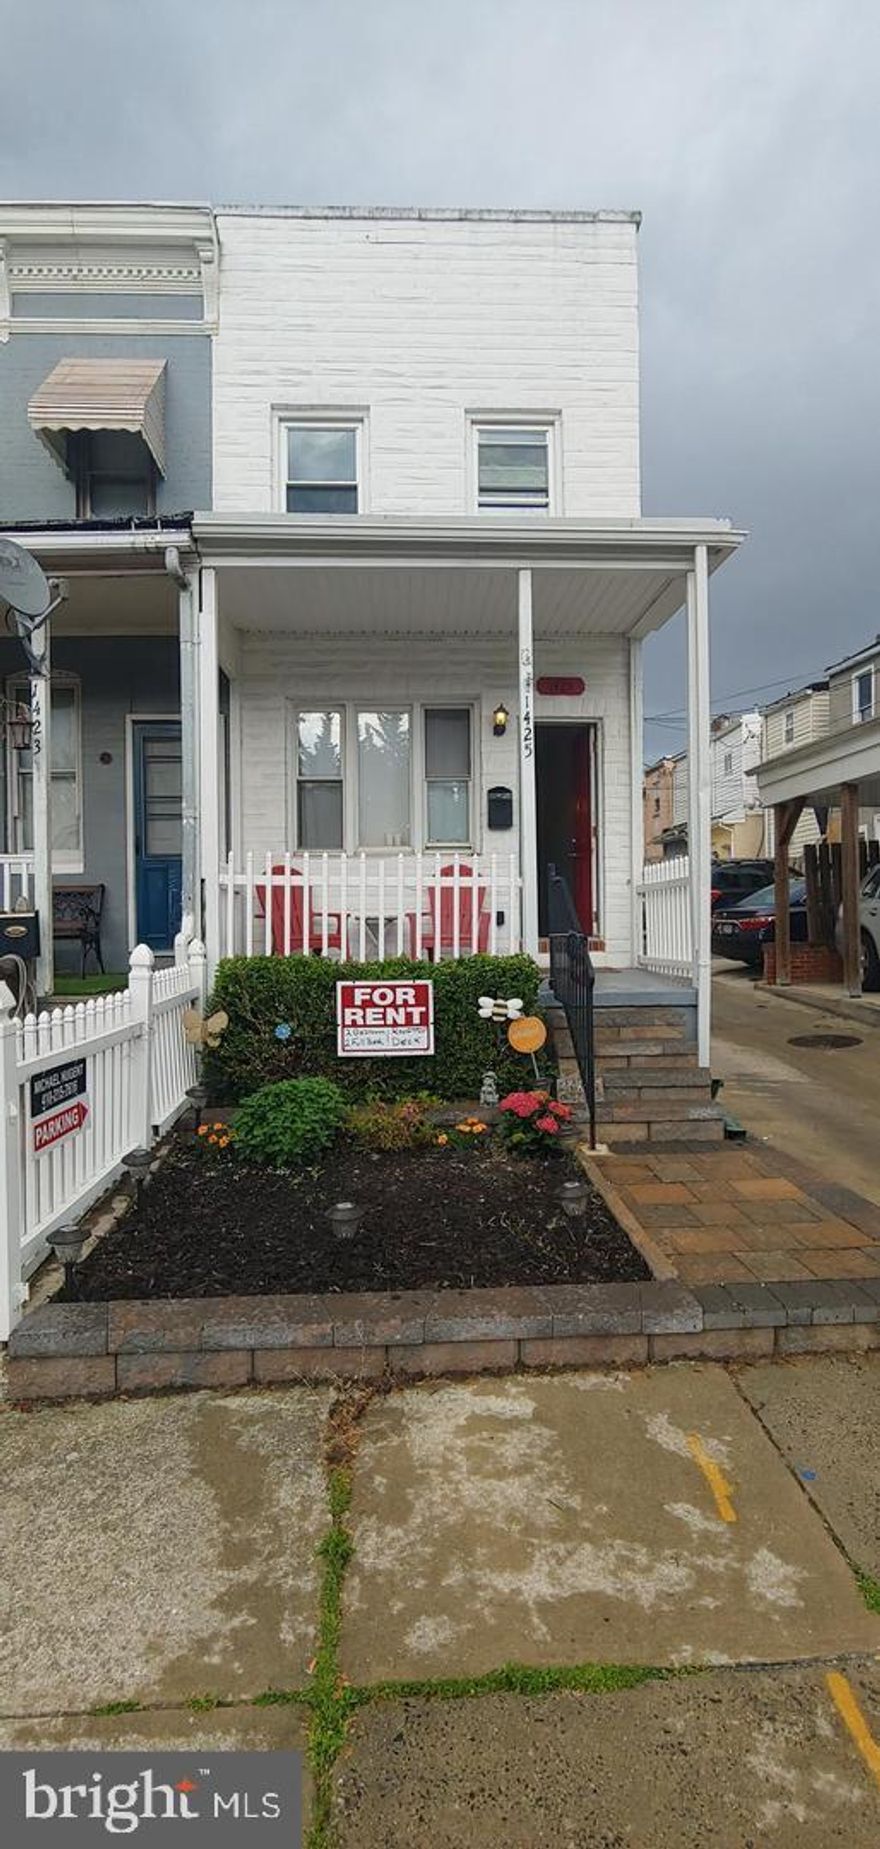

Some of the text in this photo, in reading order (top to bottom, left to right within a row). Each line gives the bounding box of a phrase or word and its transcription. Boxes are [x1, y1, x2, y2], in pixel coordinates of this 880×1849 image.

[32, 683, 42, 755] 1423
[523, 695, 533, 759] 1425
[343, 1006, 427, 1026] RENT
[353, 987, 416, 1006] FOR
[36, 1107, 79, 1148] PARKING
